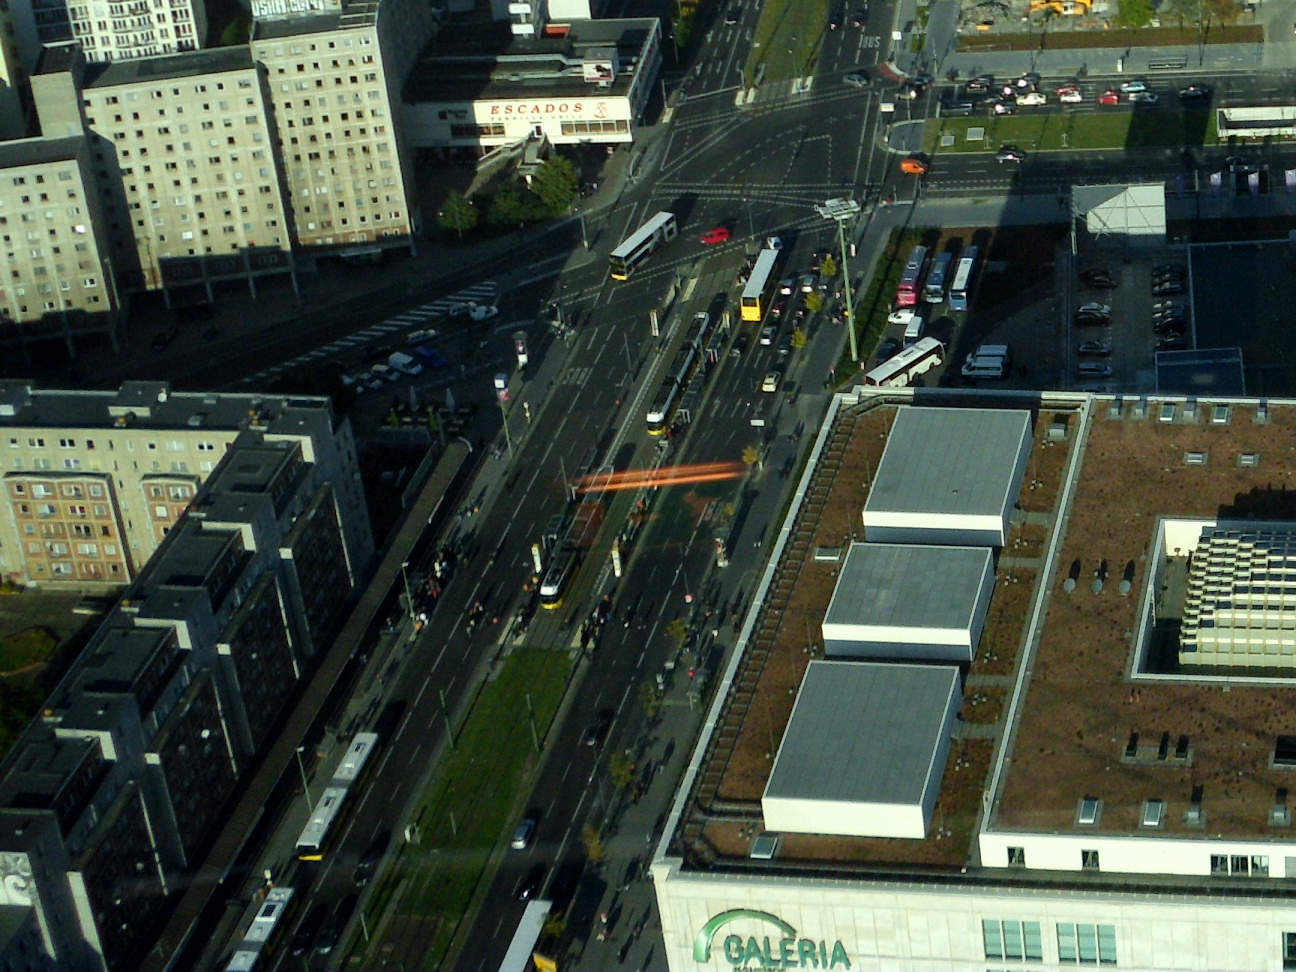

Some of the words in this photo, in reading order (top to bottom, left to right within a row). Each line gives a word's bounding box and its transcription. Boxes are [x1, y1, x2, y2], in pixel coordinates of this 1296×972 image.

[862, 36, 881, 48] BUS
[490, 103, 583, 115] ESCADOS
[723, 934, 852, 970] GALERIA
